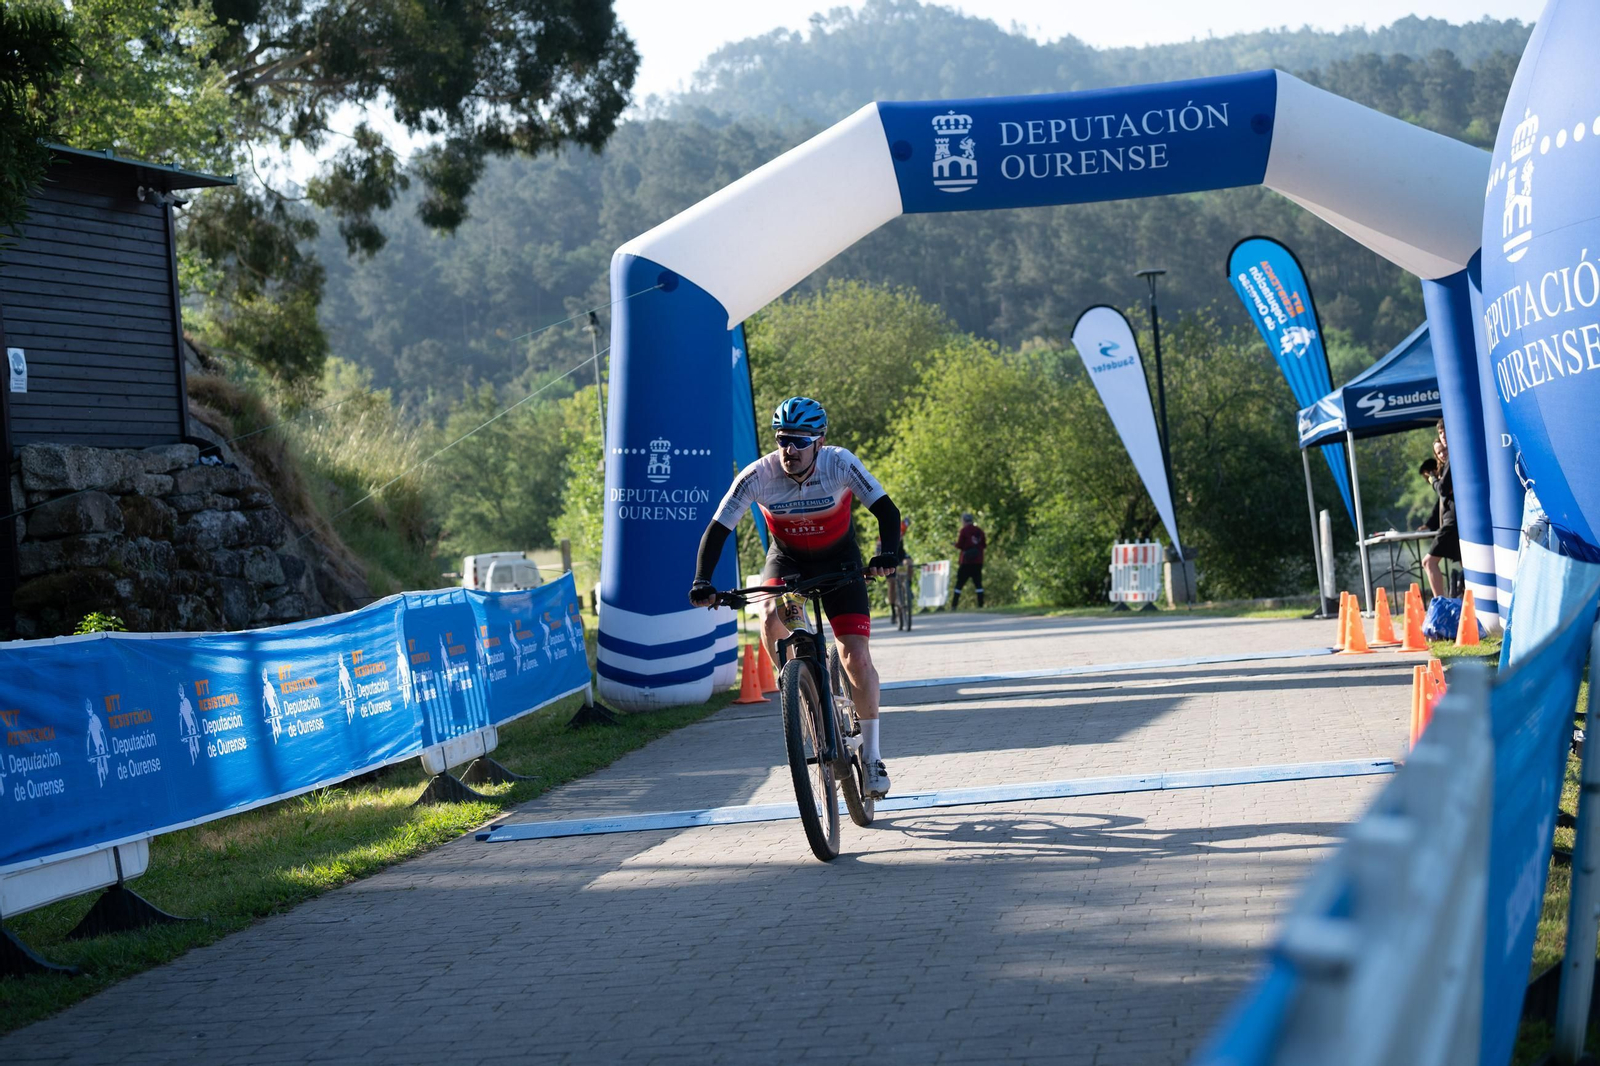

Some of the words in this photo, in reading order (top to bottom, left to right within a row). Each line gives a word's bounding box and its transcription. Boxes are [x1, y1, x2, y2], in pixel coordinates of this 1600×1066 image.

[999, 101, 1230, 146] DEPUTACIÓN
[1001, 143, 1169, 180] OURENSE
[1483, 248, 1600, 355] DEPUTACIÓ
[1497, 323, 1600, 403] OURENSE
[1388, 390, 1440, 406] Saudete
[610, 486, 709, 503] DEPUTACIÓN
[806, 498, 830, 506] EMILIO
[618, 505, 697, 520] OURENSE
[195, 679, 210, 697] BTT
[356, 677, 390, 700] Deputación
[198, 692, 239, 712] RESISTENCIA
[283, 694, 321, 718] Deputación
[360, 703, 369, 718] de
[368, 699, 393, 716] Ourense
[202, 712, 243, 737] Deputación
[288, 722, 297, 738] de
[296, 717, 325, 735] Ourense
[112, 730, 157, 756] Deputación
[207, 741, 217, 758] de
[216, 736, 247, 756] Ourense
[9, 748, 61, 777] Deputación
[117, 762, 128, 780] de
[128, 757, 162, 777] Ourense
[14, 782, 26, 802] de
[27, 778, 65, 799] Ourense
